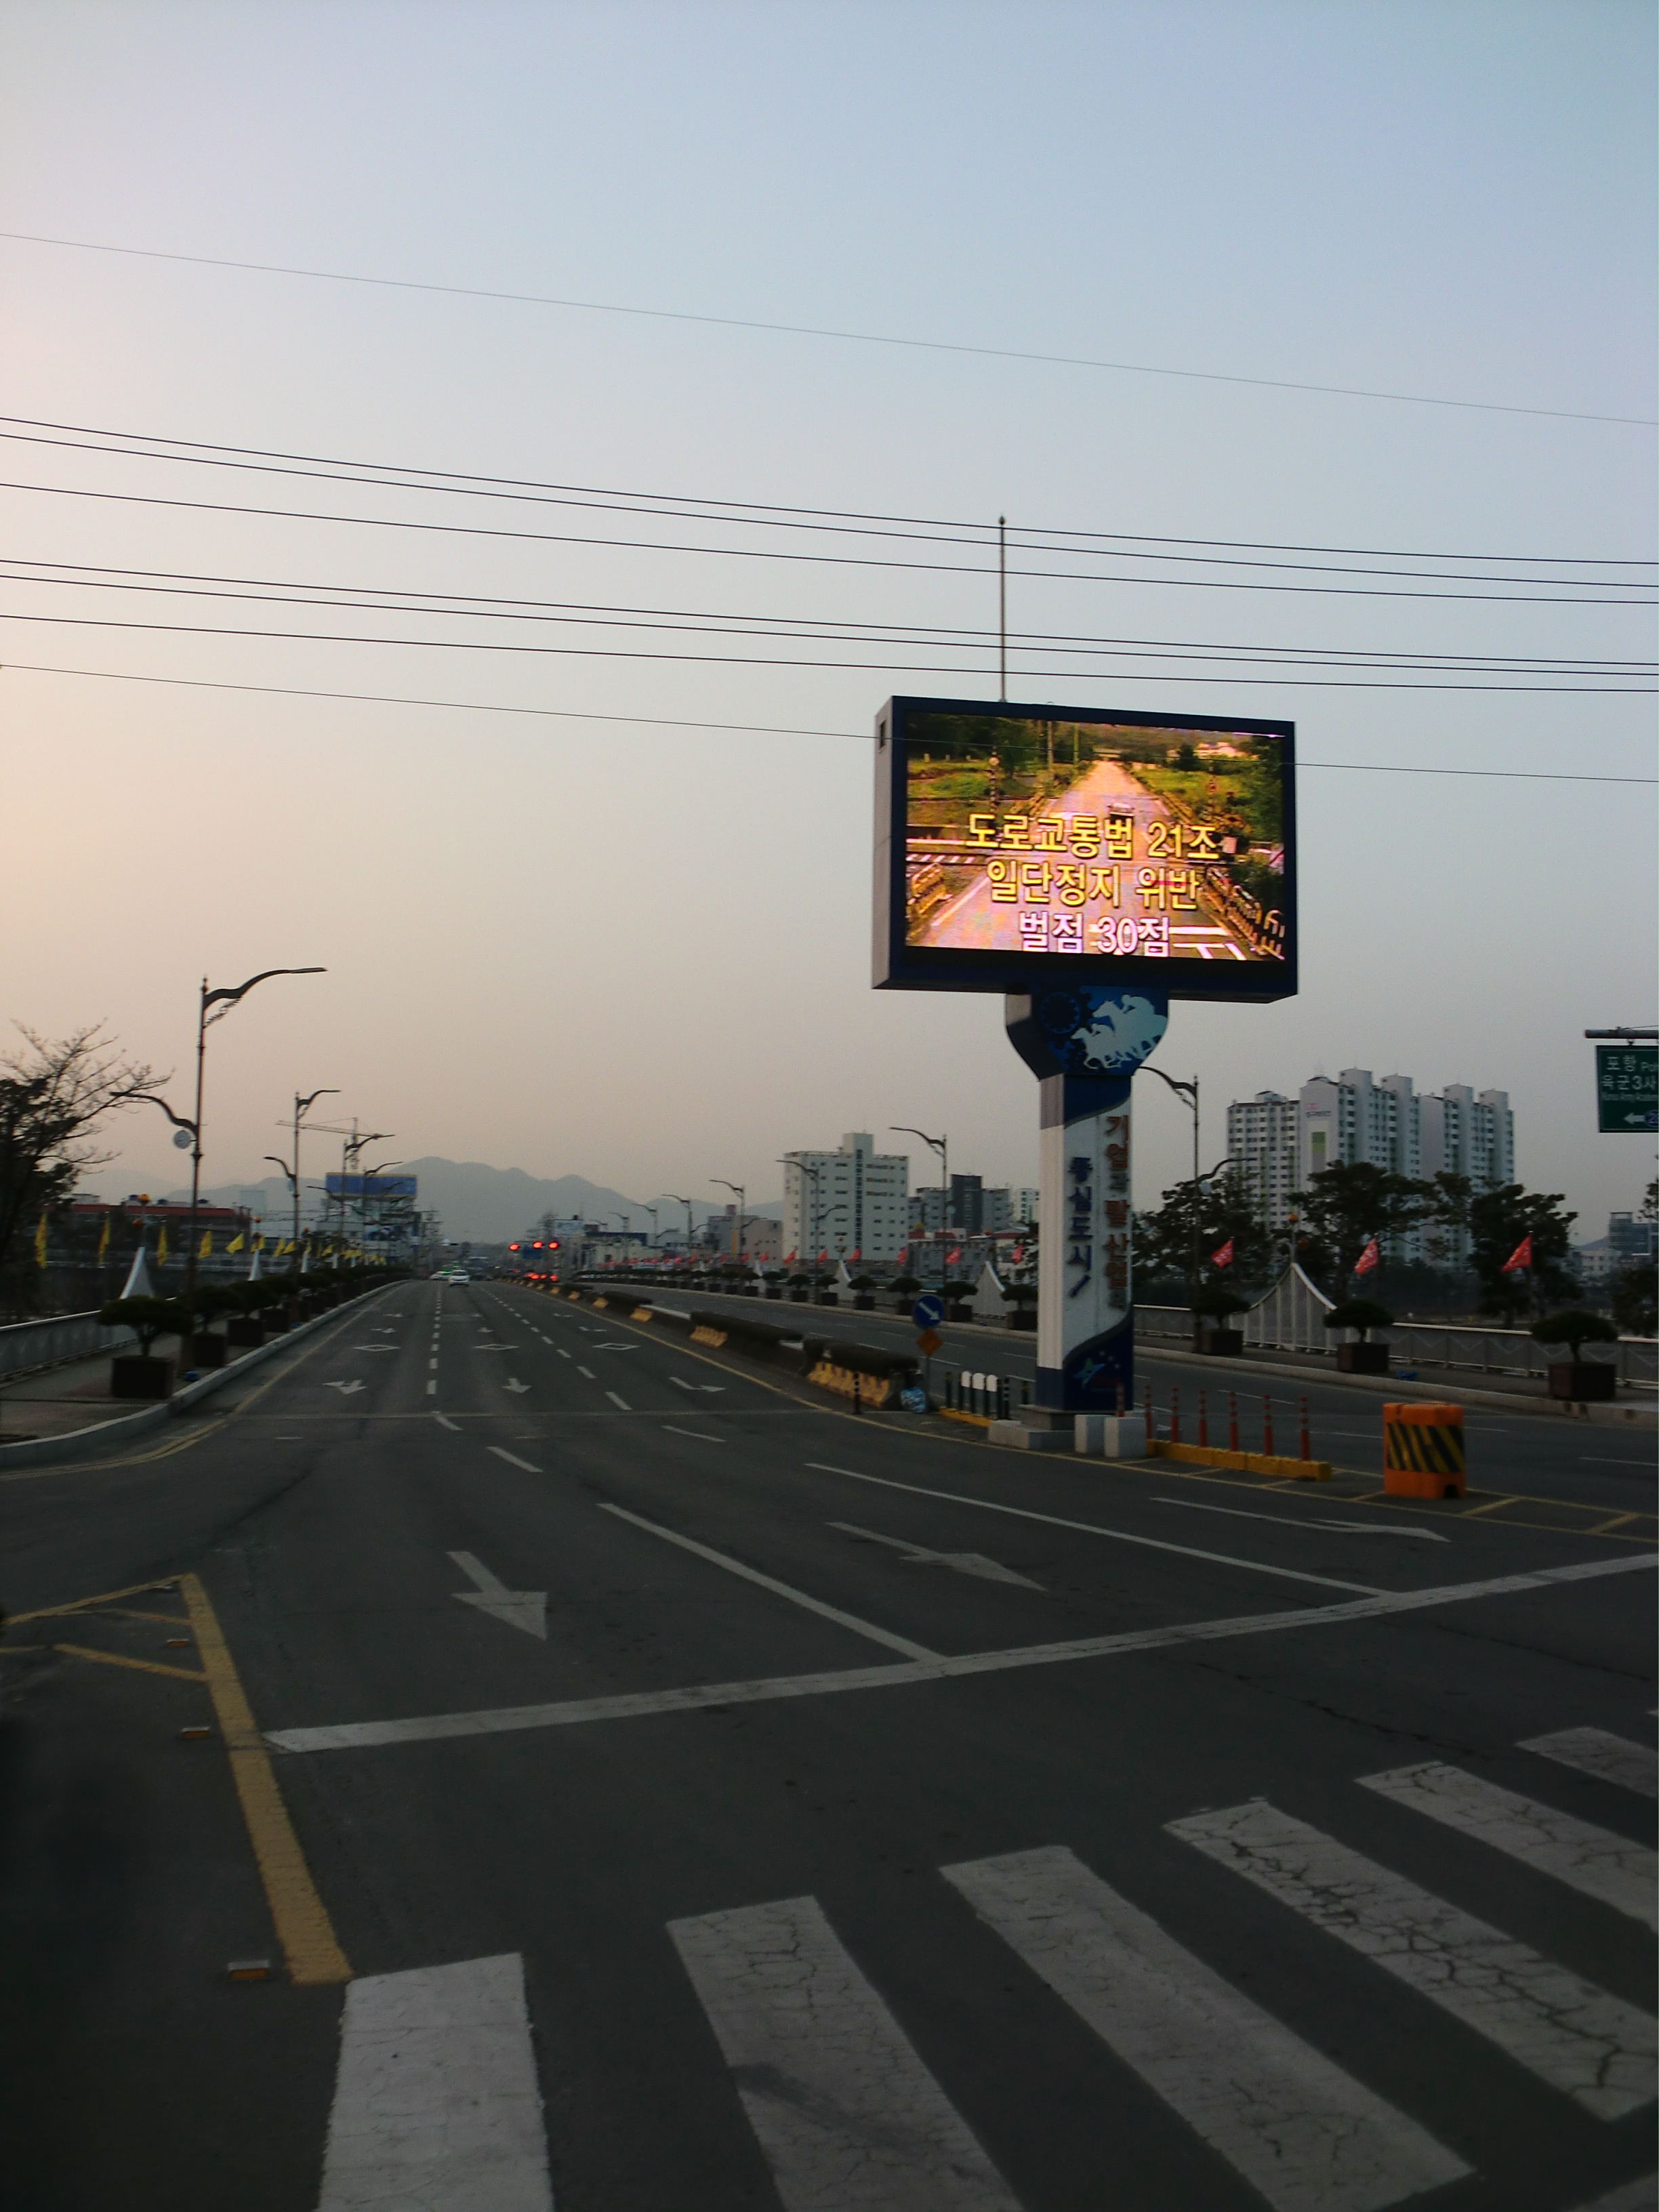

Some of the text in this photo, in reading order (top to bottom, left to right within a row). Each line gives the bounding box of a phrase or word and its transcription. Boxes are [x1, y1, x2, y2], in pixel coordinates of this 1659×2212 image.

[965, 813, 1220, 860] 도로교통법 21조
[986, 859, 1201, 911] 일단정지 위반
[1019, 911, 1170, 958] 벌점 30점
[1606, 1055, 1637, 1072] 포항
